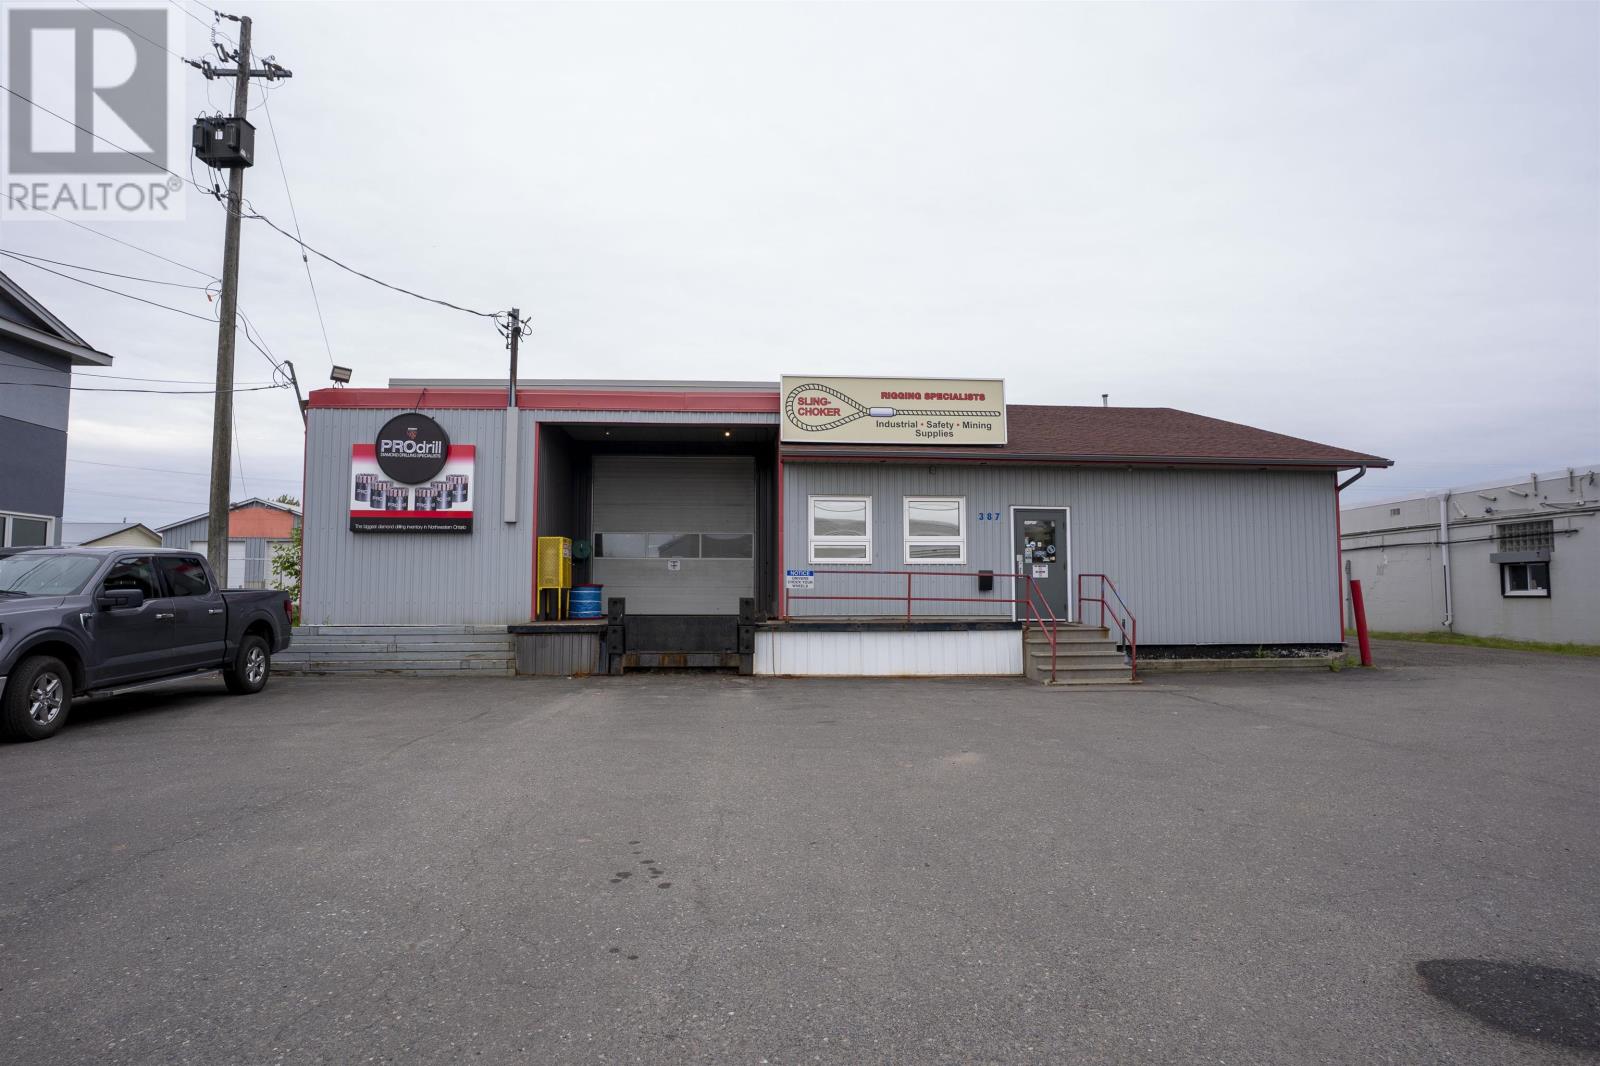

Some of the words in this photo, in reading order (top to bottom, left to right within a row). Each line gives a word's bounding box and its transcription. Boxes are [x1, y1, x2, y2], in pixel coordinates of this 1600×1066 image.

[880, 391, 922, 400] RIGGING
[924, 392, 986, 401] SPECIALISTS
[797, 397, 832, 406] SLING-
[797, 407, 841, 417] CHOKER
[875, 420, 918, 429] Industrial
[926, 421, 954, 431] Safety
[962, 421, 992, 431] Mining
[915, 429, 954, 438] Supplies
[380, 439, 442, 454] PROdrill
[978, 512, 1000, 521] 387
